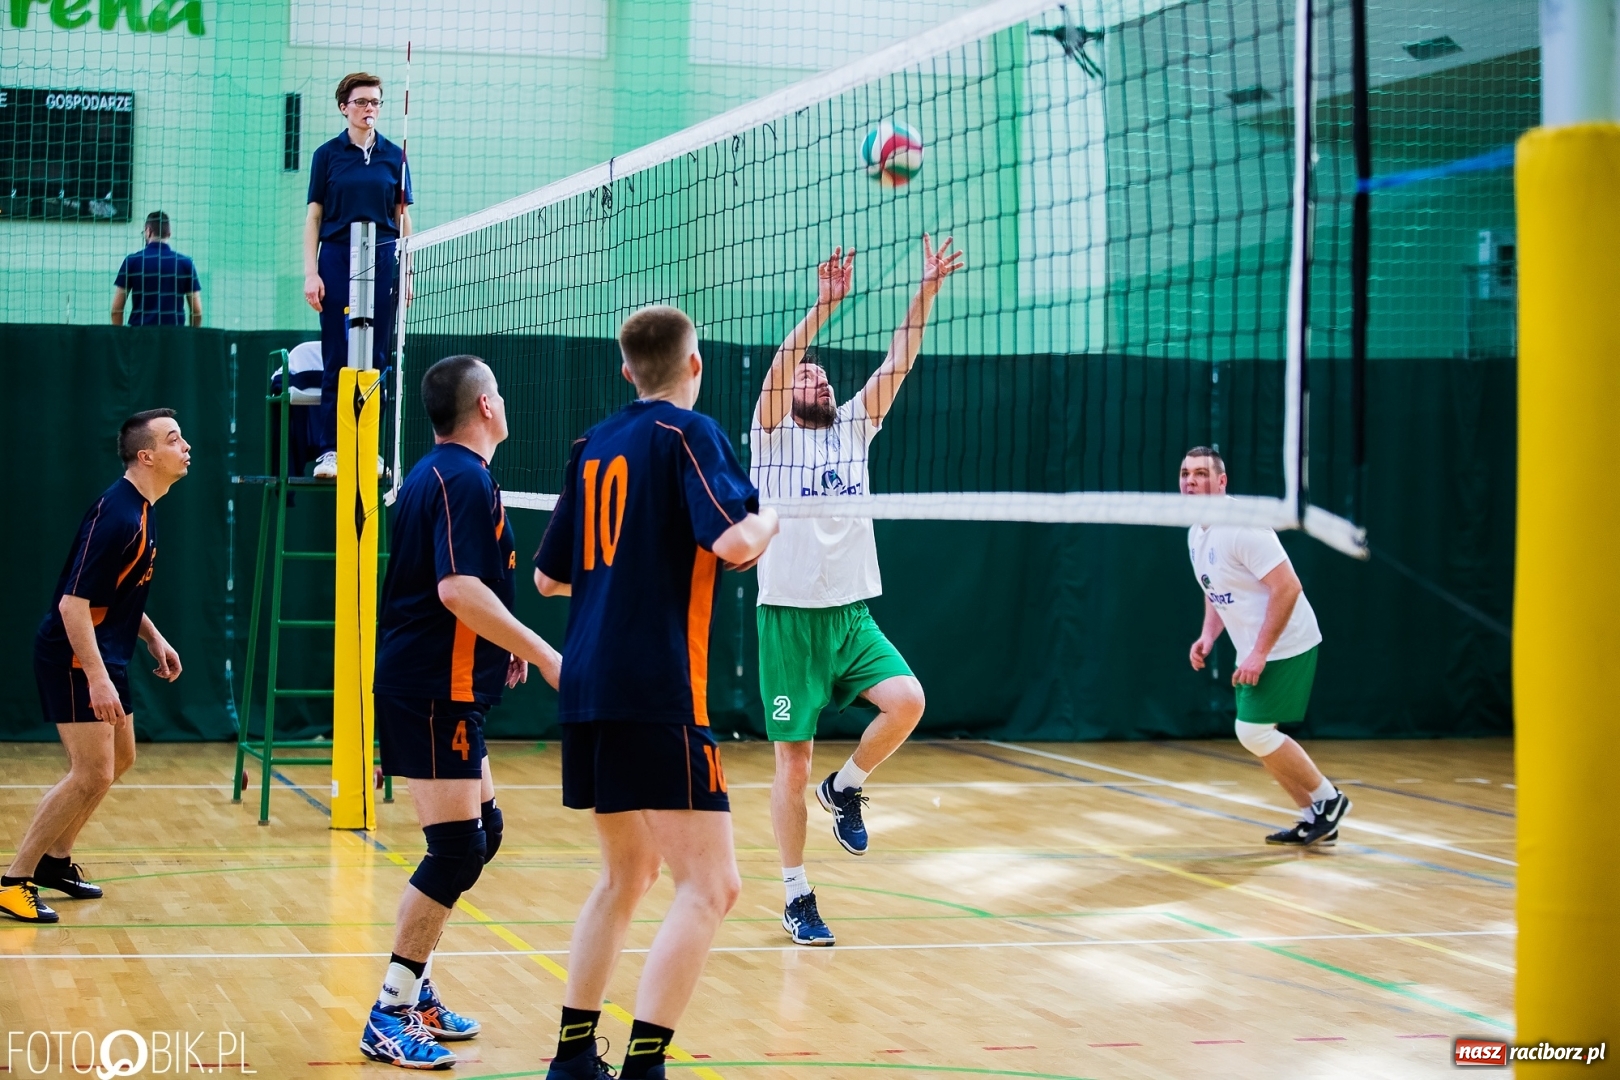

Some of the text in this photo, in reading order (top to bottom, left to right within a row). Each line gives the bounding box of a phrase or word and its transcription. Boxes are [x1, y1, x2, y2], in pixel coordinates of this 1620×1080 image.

[45, 94, 133, 112] GOSPODARZE
[583, 455, 628, 570] 10
[772, 695, 791, 721] 2
[452, 720, 470, 761] 4
